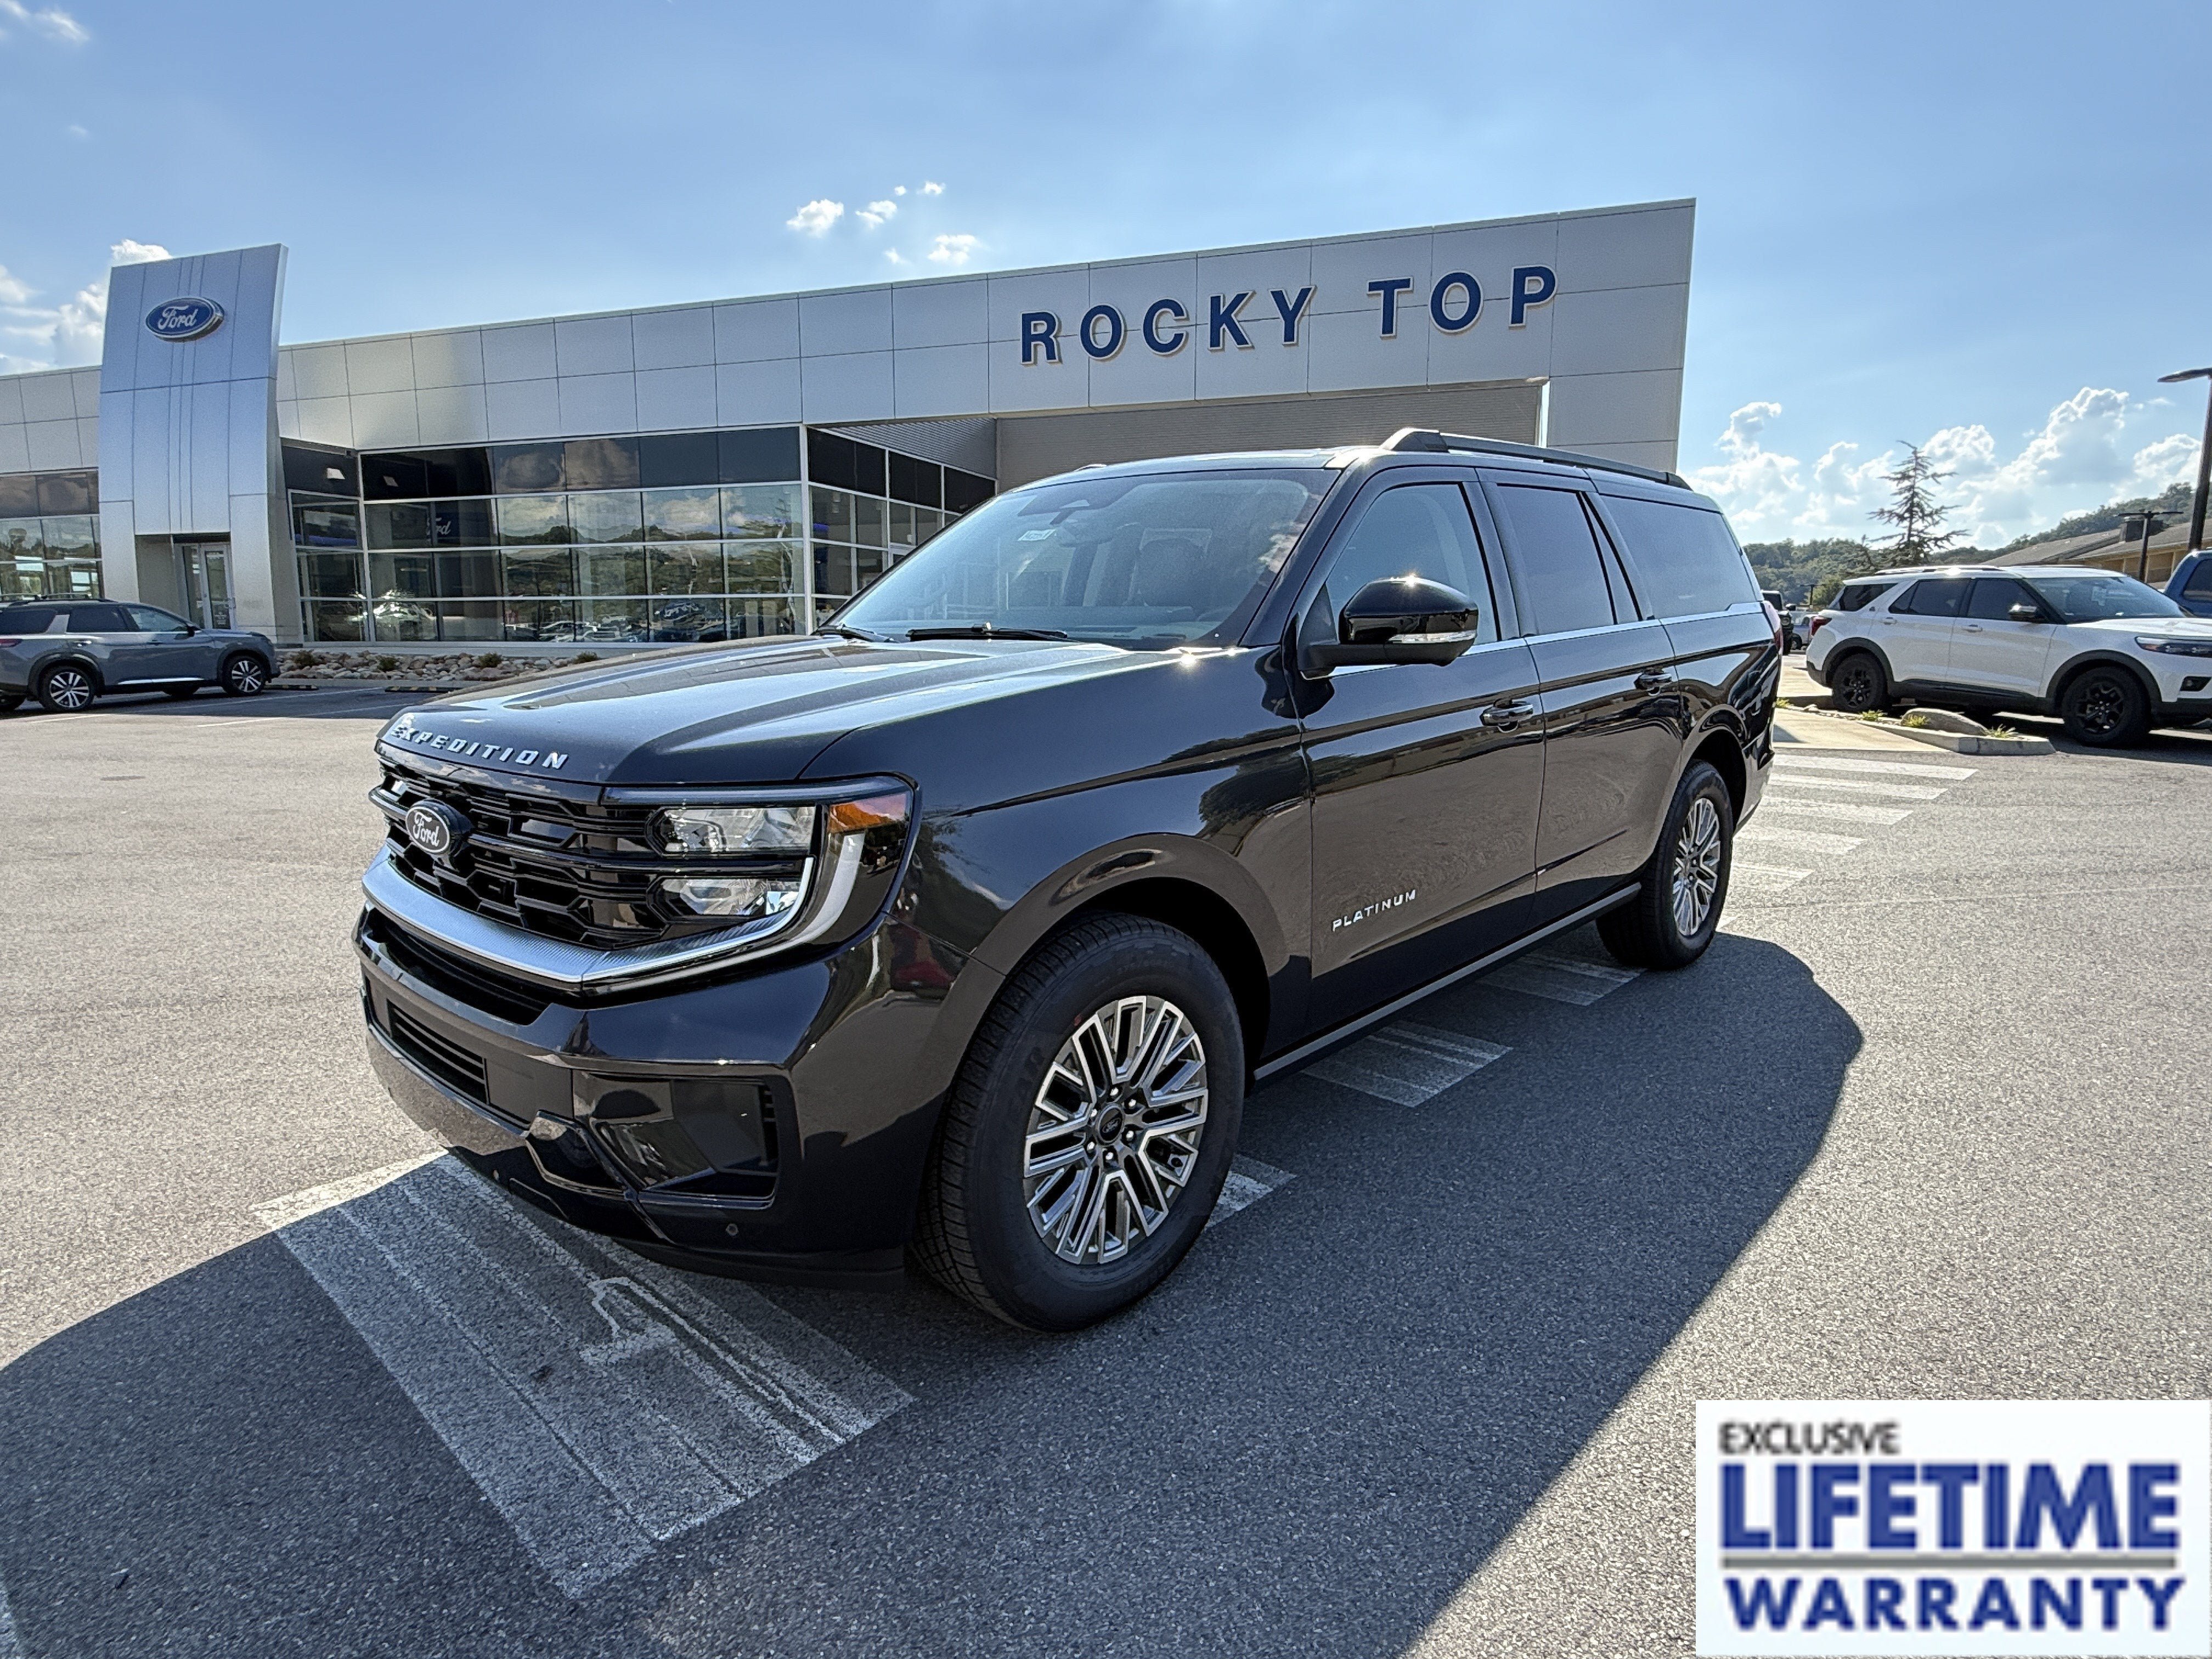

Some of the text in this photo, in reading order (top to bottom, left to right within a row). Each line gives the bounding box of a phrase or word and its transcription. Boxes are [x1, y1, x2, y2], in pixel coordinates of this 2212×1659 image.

[158, 306, 199, 330] Ford
[1020, 265, 1559, 365] ROCKY TOP
[390, 725, 568, 769] EXPEDITION
[413, 811, 440, 847] Ford
[1332, 889, 1416, 933] PLATINUM
